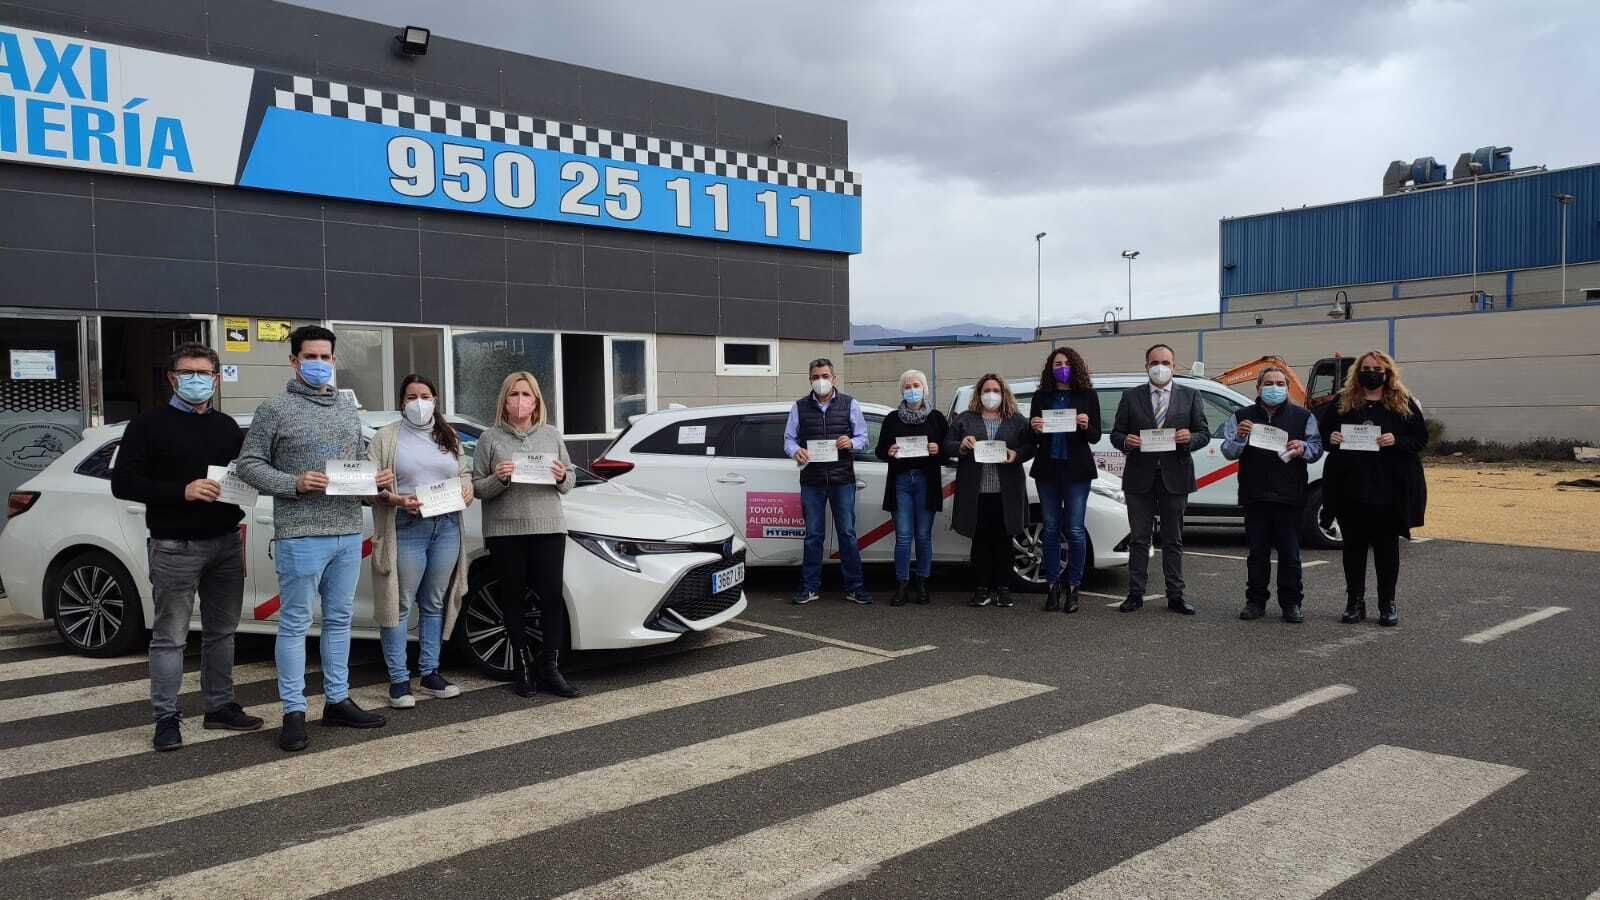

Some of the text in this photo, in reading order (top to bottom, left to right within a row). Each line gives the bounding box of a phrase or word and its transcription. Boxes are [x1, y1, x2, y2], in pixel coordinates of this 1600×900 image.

[387, 135, 812, 241] 950 25 11 11
[750, 506, 784, 514] TOYOTA
[749, 515, 790, 525] ALBORÁN
[766, 528, 806, 537] HYBRID
[718, 569, 734, 589] 3667
